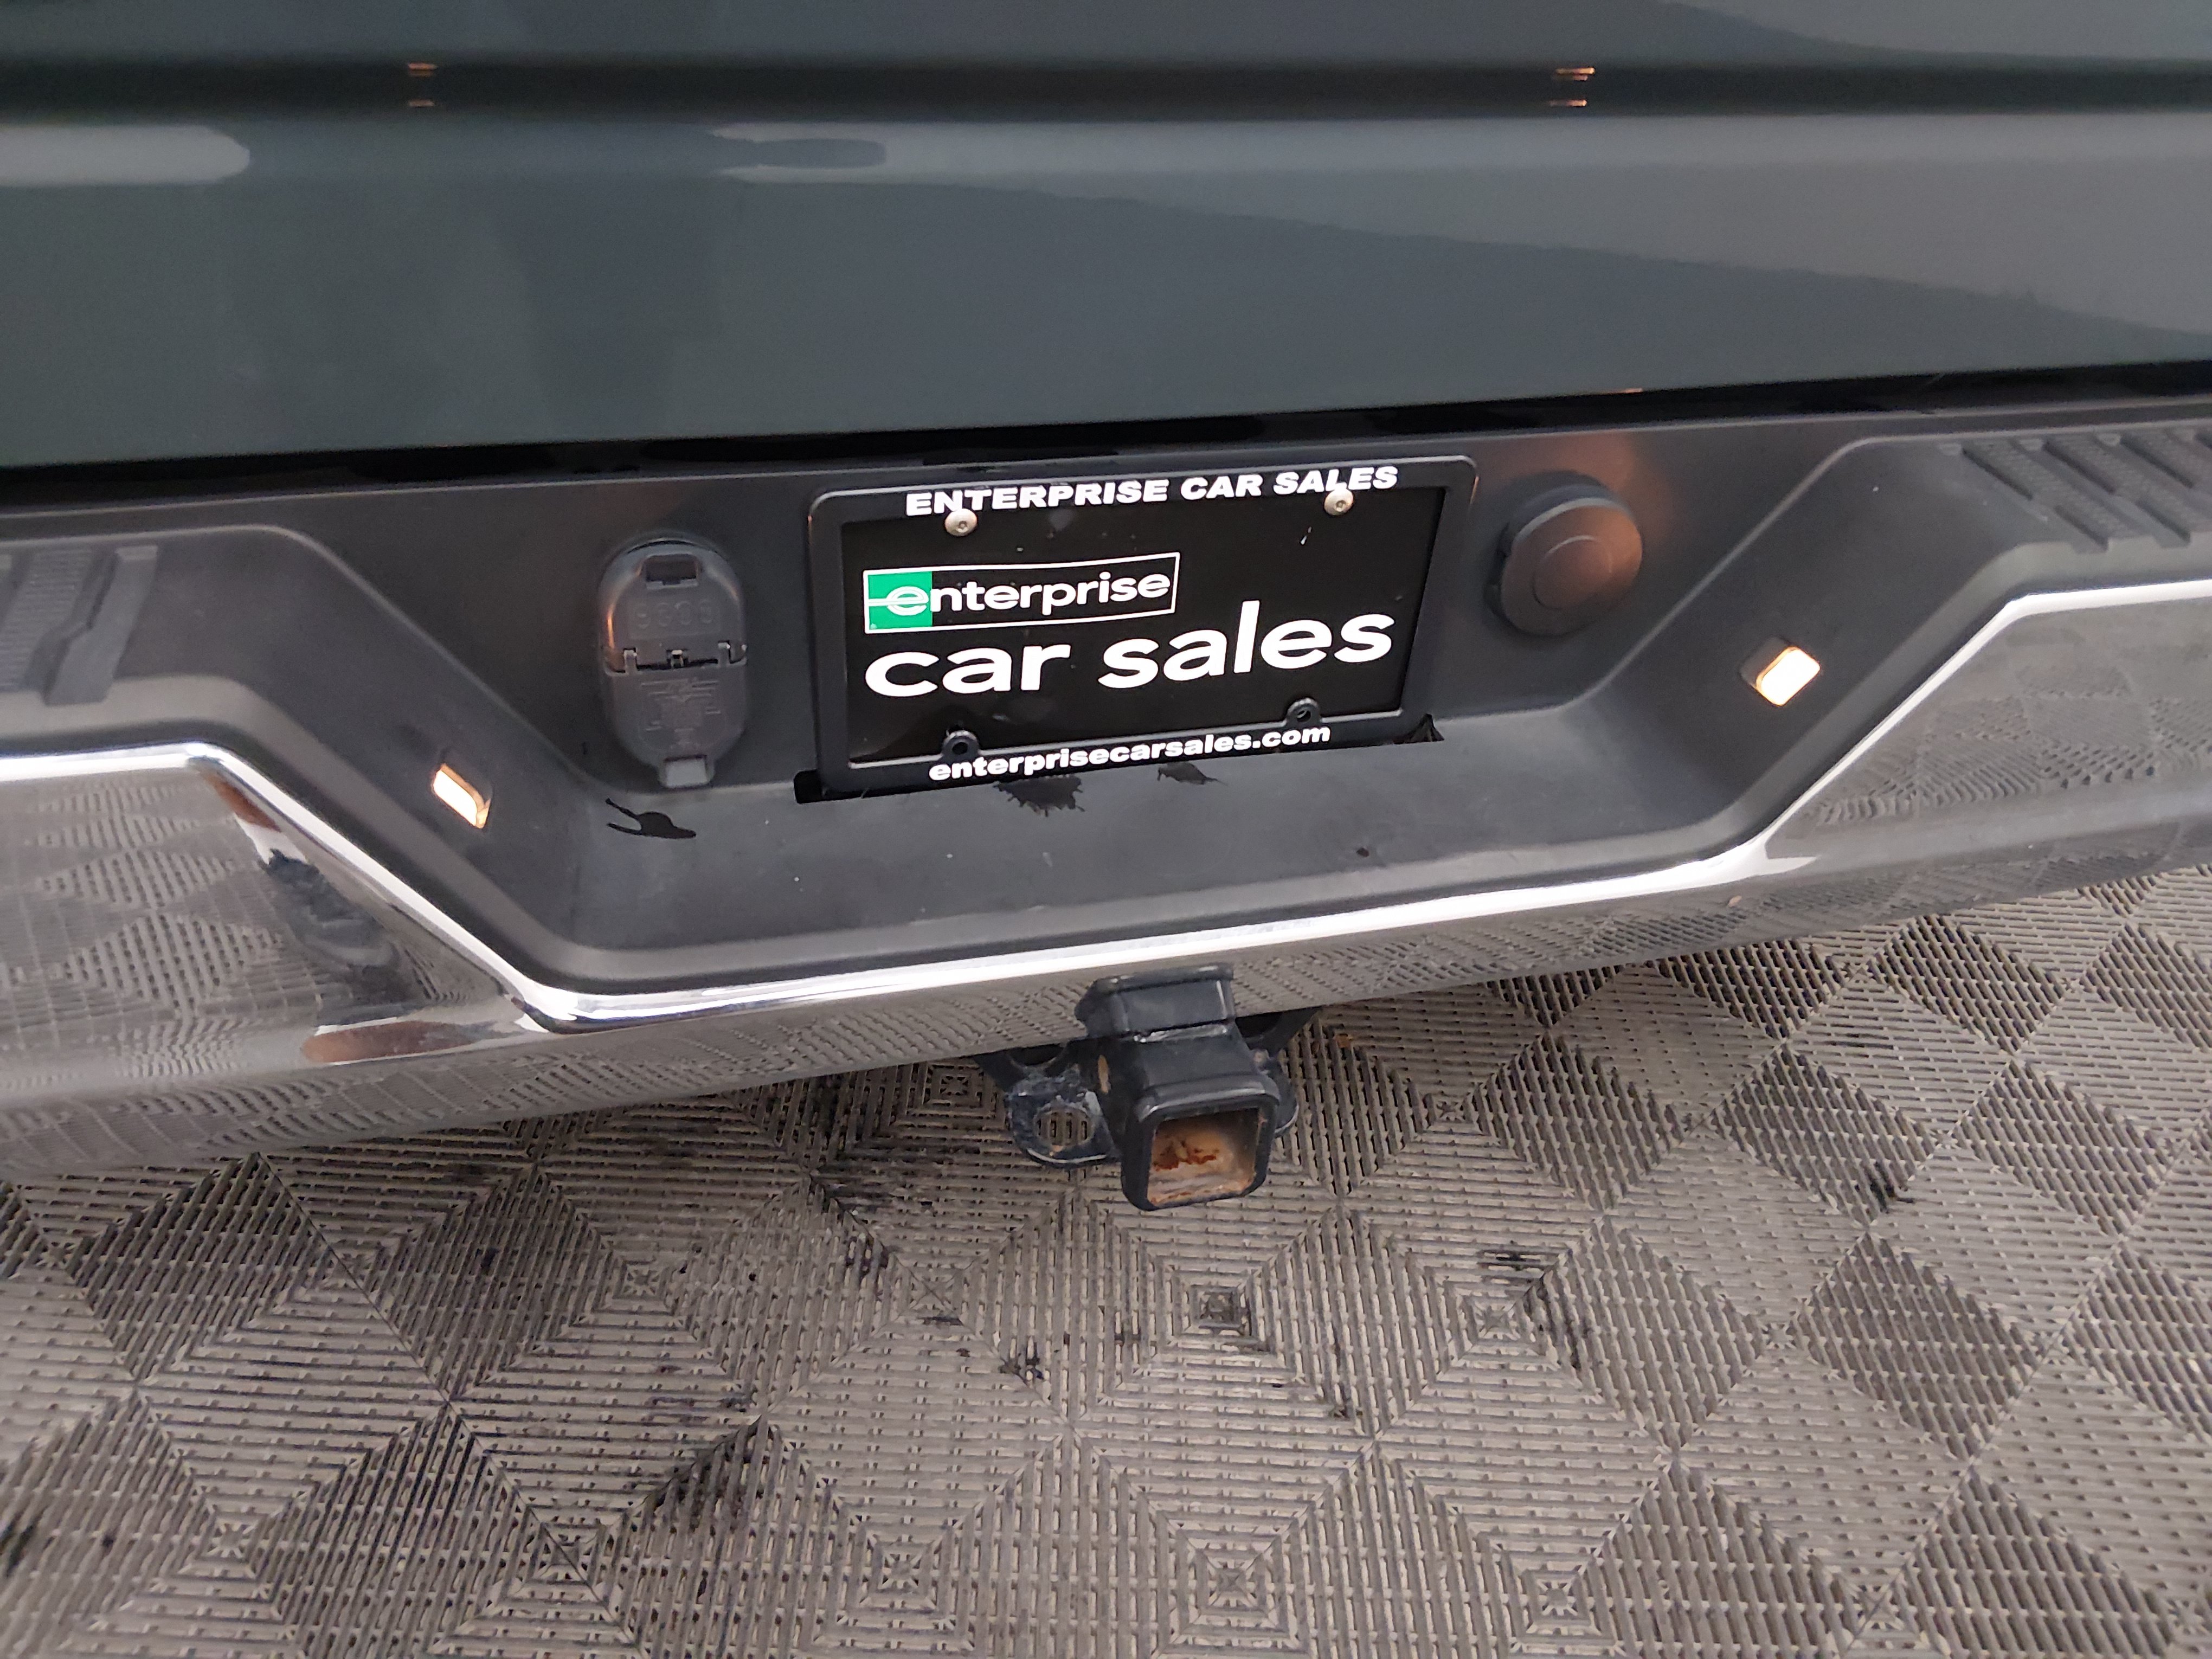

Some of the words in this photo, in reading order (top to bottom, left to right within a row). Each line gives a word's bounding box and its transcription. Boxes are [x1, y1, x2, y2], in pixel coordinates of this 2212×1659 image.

[905, 478, 1170, 516] ENTERPRISE
[1180, 473, 1263, 501] CAR
[1272, 465, 1399, 496] SALES
[886, 570, 1171, 617] enterprise
[864, 644, 1072, 698] car
[1097, 600, 1395, 689] sales
[928, 726, 1331, 781] enterprisecarsales.com
